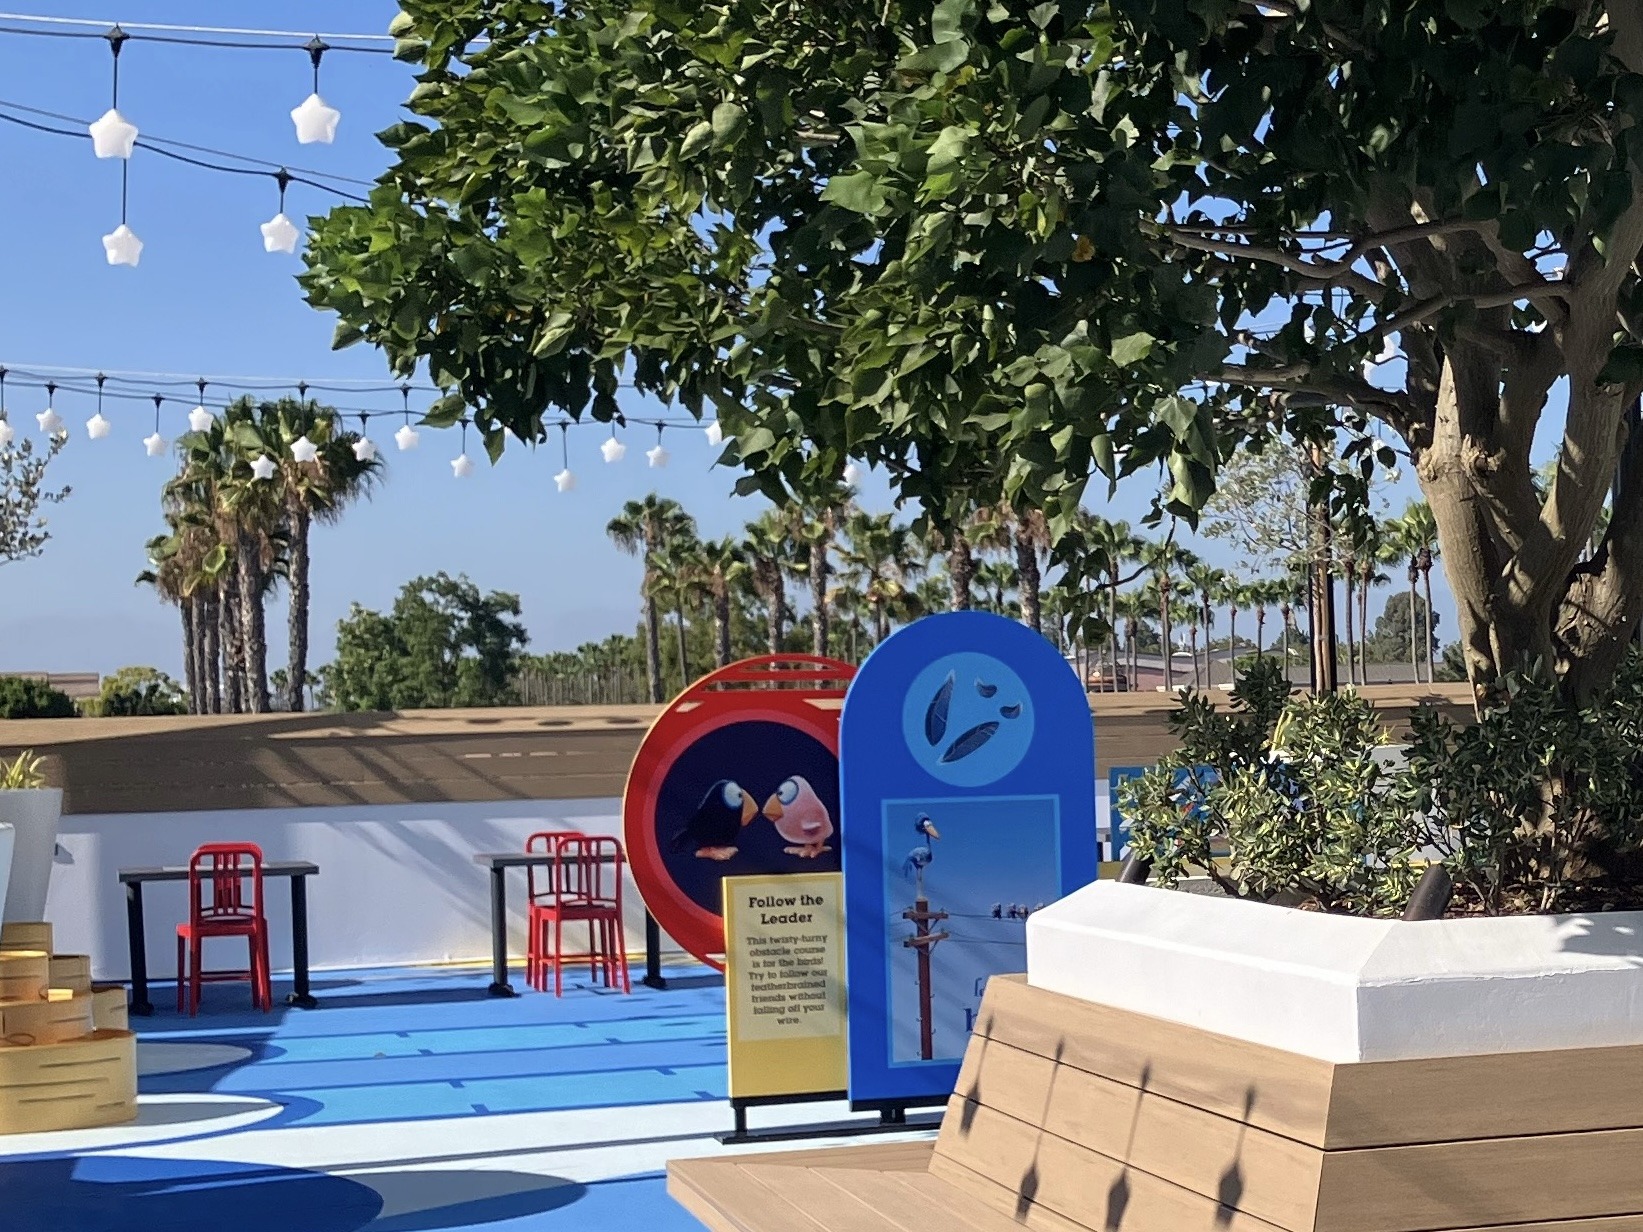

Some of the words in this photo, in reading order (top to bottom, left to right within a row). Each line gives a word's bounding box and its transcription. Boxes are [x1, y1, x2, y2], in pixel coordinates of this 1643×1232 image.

[749, 896, 796, 908] Follow
[801, 895, 823, 906] the
[761, 913, 813, 924] Leader
